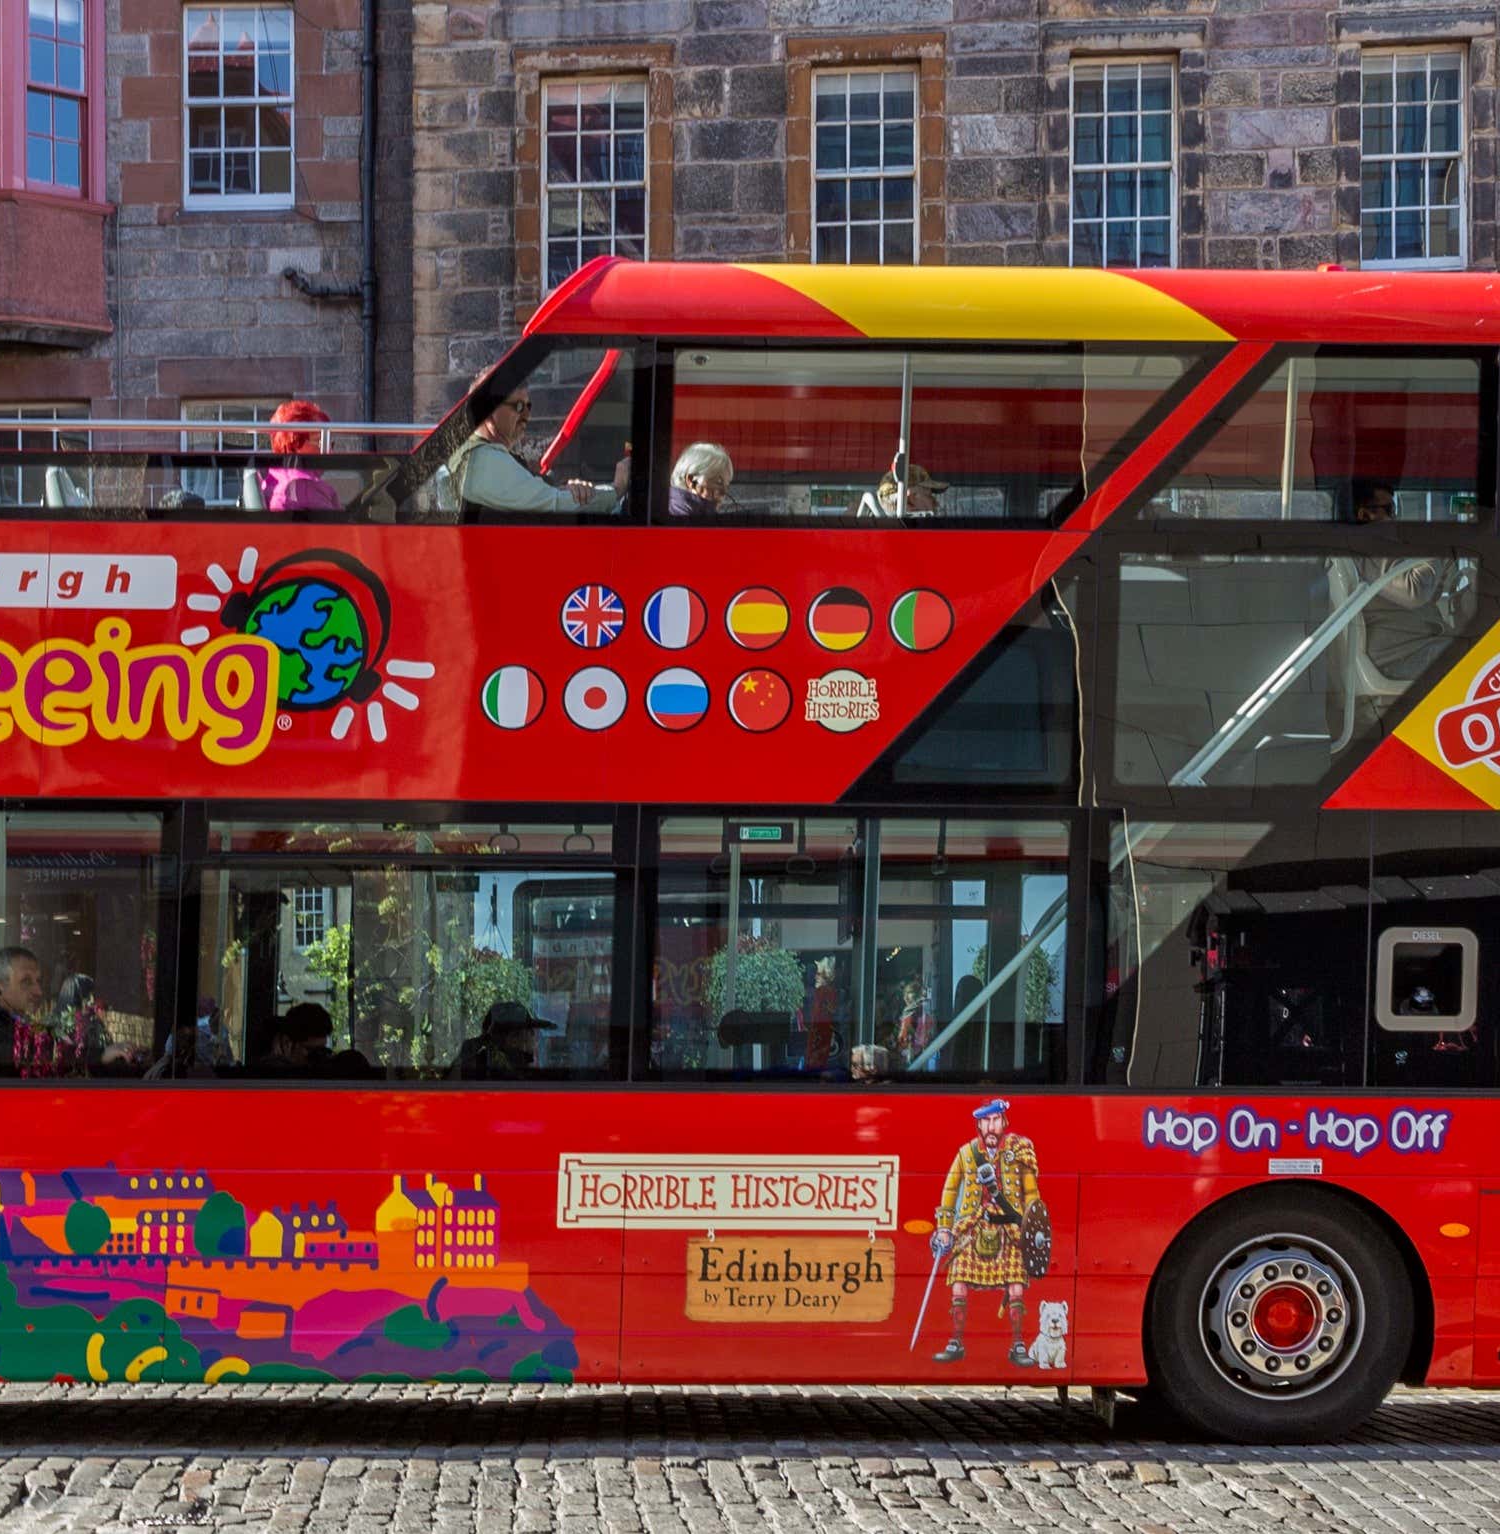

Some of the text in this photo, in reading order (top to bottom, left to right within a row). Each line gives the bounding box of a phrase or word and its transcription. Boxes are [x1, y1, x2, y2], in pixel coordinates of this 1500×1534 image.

[1412, 930, 1443, 941] DIESEL
[1145, 1109, 1219, 1154] Hop
[1227, 1108, 1278, 1150] On
[1308, 1110, 1380, 1154] Hop
[1390, 1109, 1449, 1151] Off
[699, 1246, 885, 1294] Edinburgh
[703, 1287, 842, 1315] by Terry Deary
